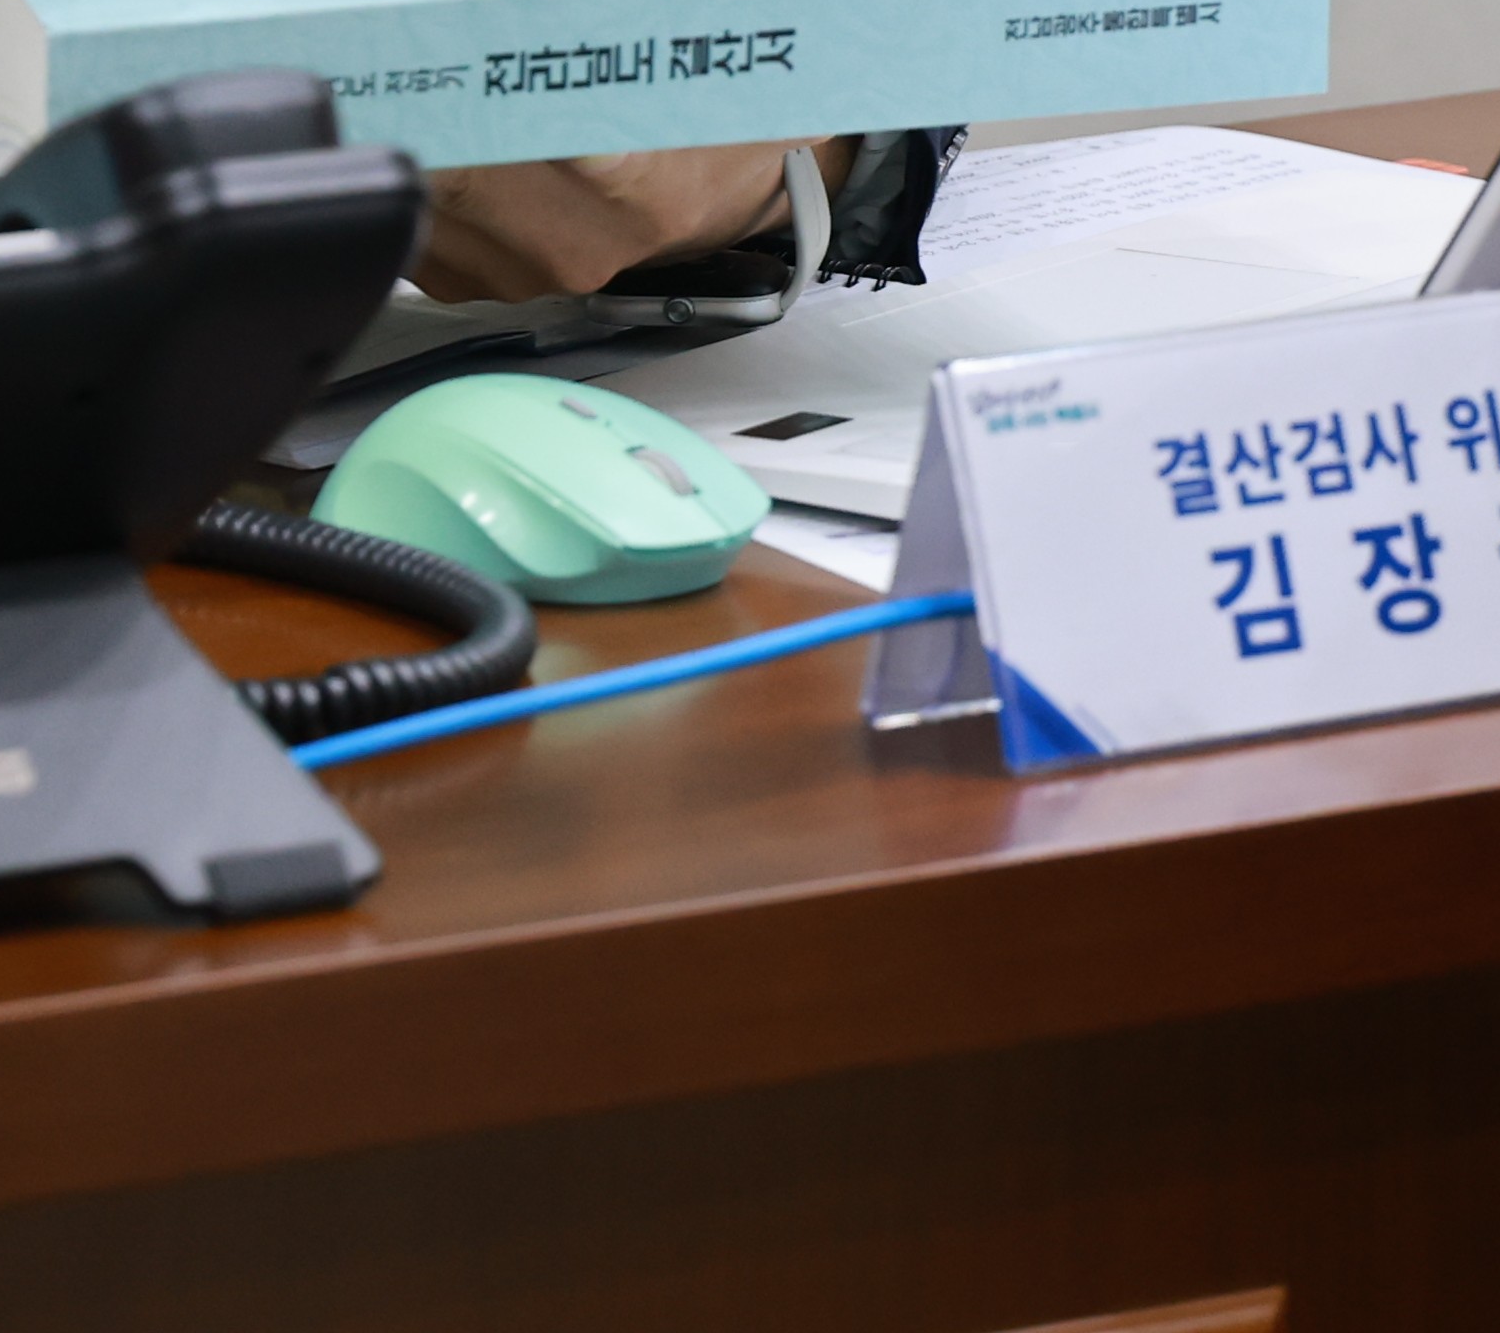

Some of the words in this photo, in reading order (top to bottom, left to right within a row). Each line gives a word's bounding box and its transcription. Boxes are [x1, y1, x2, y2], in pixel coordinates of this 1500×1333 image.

[483, 37, 657, 98] 전라남도
[667, 26, 798, 81] 결산서
[1152, 401, 1424, 519] 결산검사
